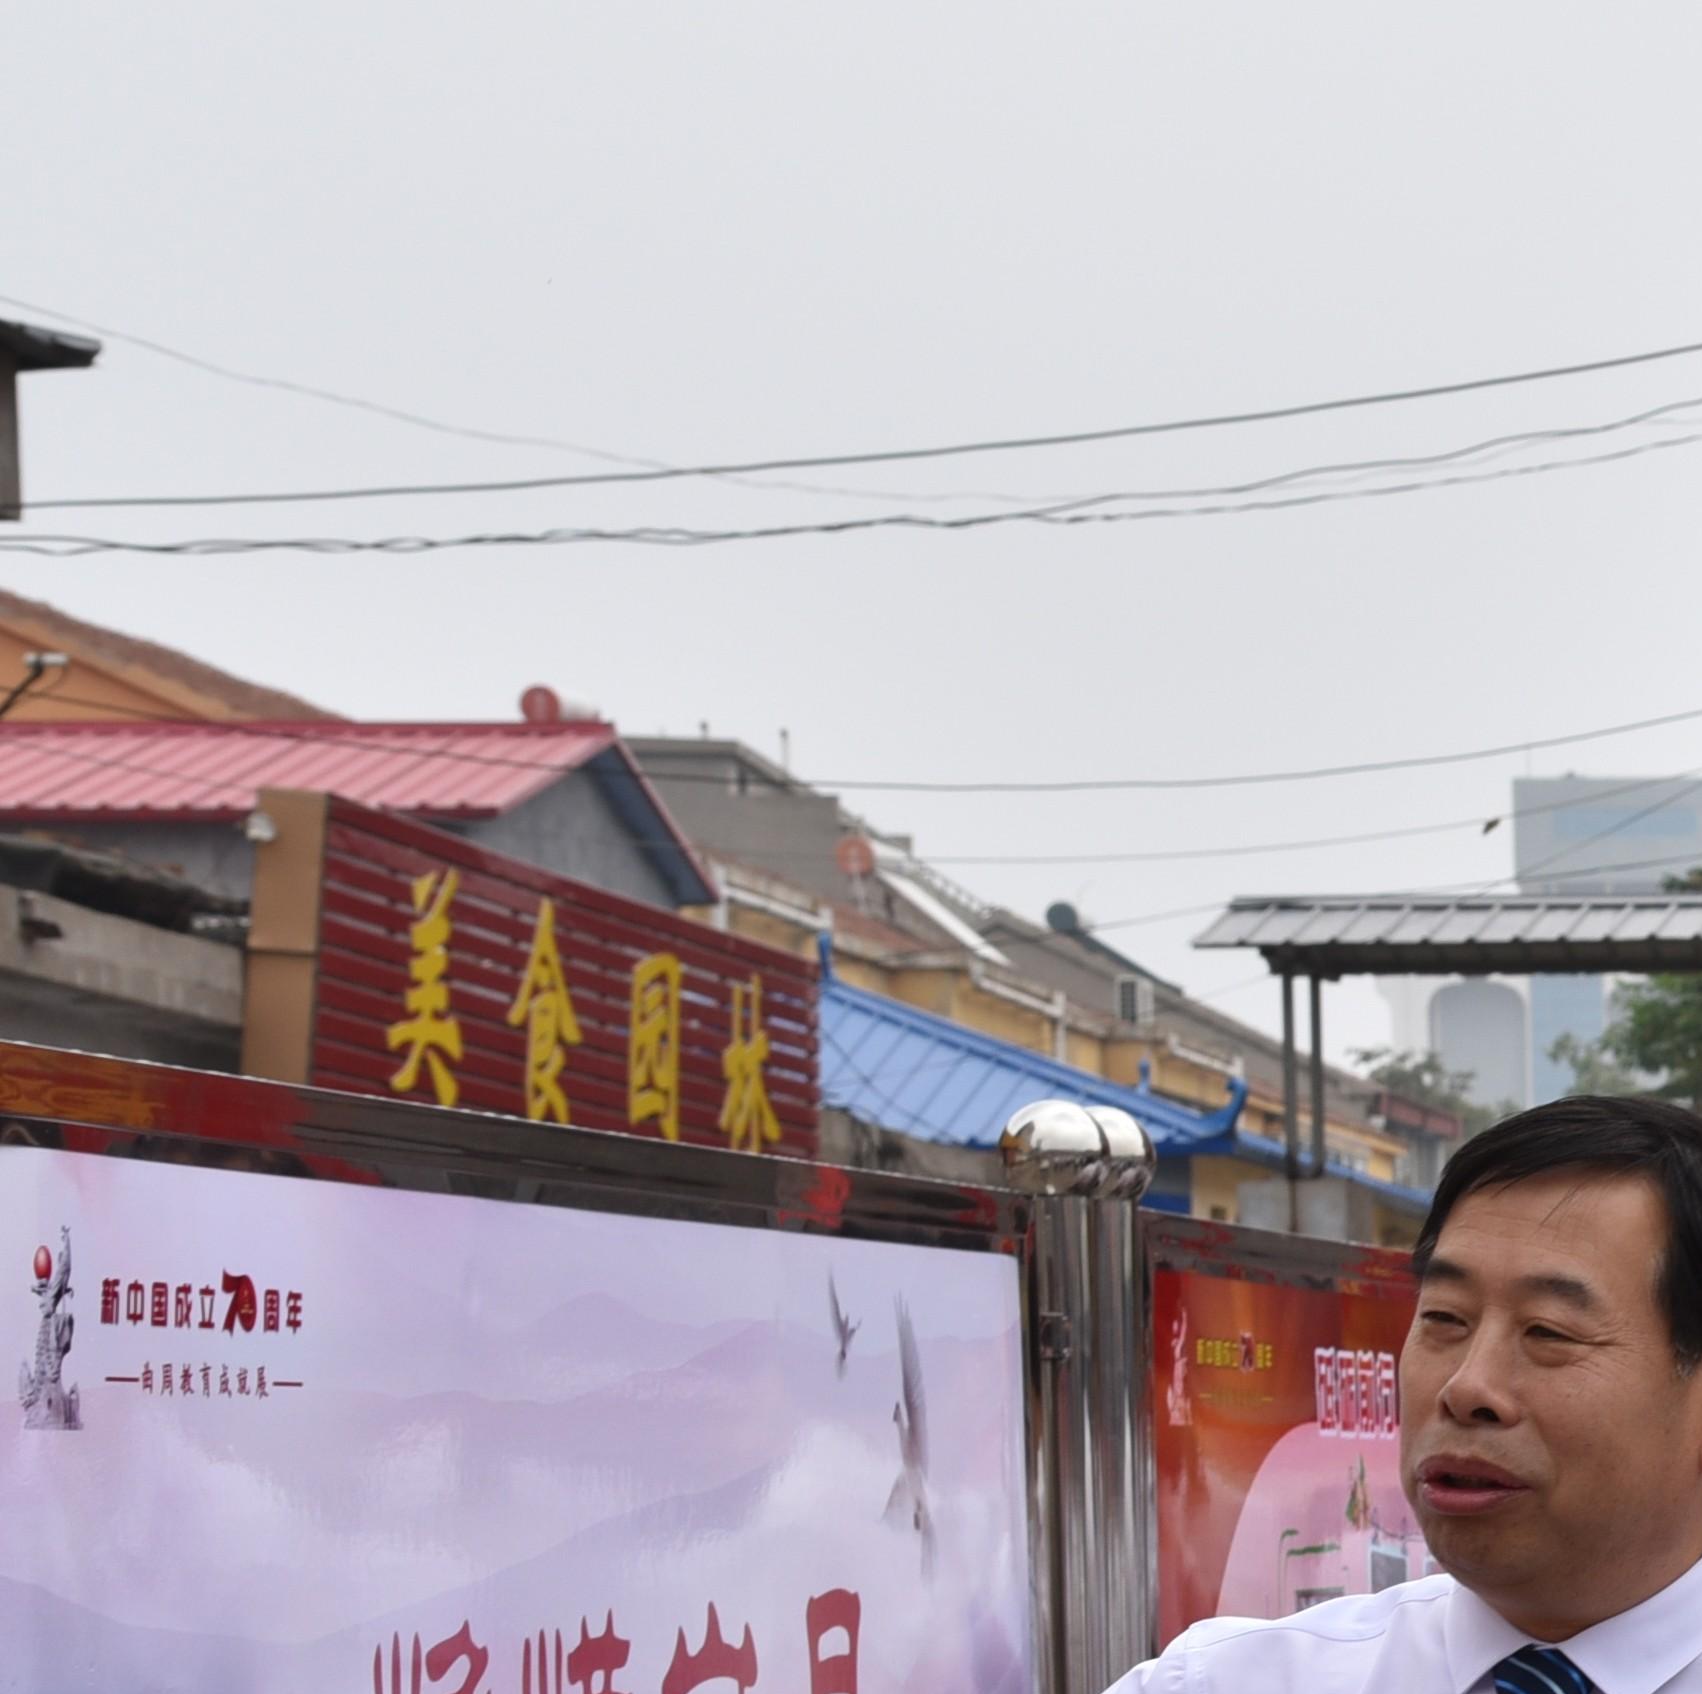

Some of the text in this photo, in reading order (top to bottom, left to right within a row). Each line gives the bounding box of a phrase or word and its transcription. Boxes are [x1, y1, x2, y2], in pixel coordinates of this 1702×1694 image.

[99, 1267, 304, 1337] 新中国成立70周年
